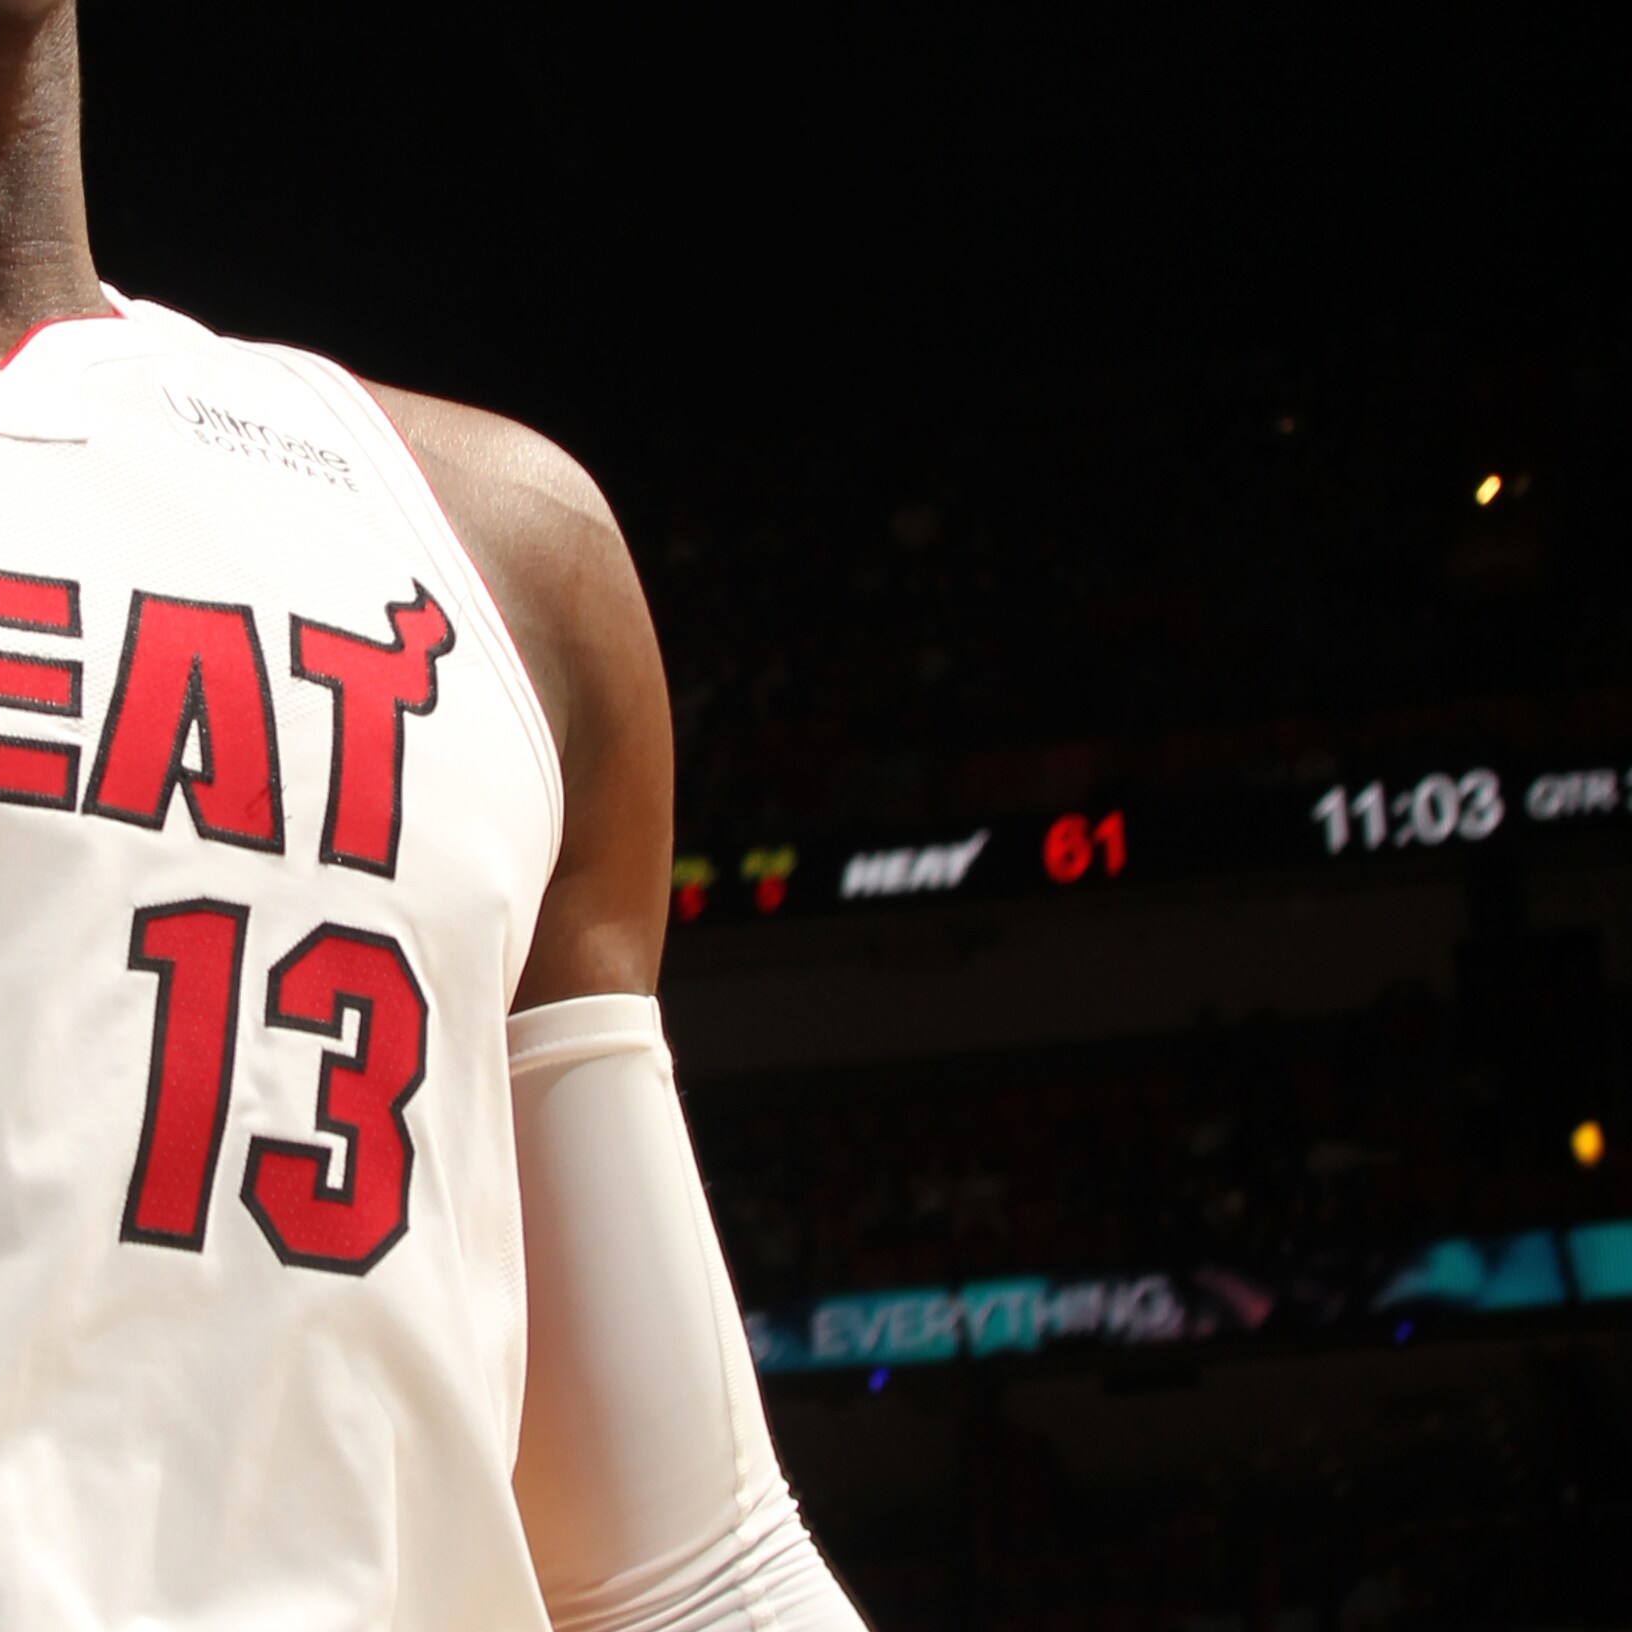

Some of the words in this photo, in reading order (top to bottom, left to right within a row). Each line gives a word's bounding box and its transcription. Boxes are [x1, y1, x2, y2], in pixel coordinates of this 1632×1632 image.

[162, 386, 351, 474] Ultimate
[193, 428, 360, 494] SOFTWARE
[1044, 810, 1126, 885] 61
[1313, 768, 1505, 854] 11:03
[119, 896, 429, 1278] 13
